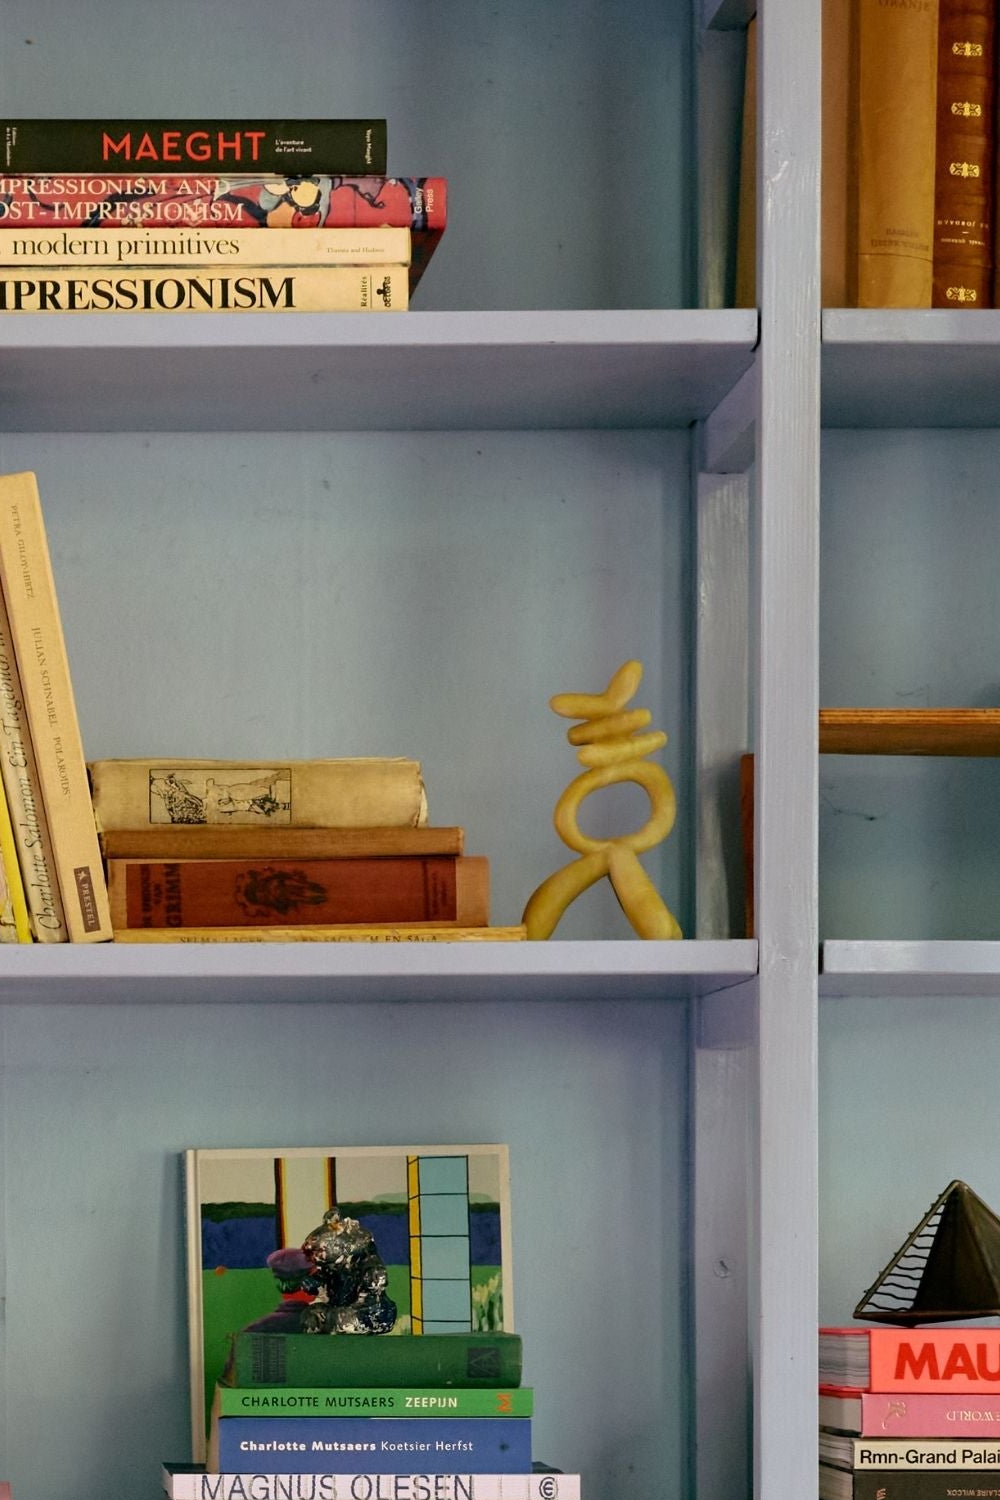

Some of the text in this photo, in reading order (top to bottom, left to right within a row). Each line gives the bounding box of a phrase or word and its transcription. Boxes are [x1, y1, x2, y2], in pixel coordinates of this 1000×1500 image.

[101, 131, 266, 162] MAEGHT
[176, 178, 232, 196] AND
[51, 201, 244, 222] IMPRESSIONISM
[12, 232, 241, 262] modern primitives
[31, 626, 72, 800] JULIAN SCHNABEL POLAROIDS
[19, 777, 62, 930] Charlotte Salomon
[241, 1396, 458, 1409] CHARLOTTE MUTSAERS ZEEPIJN
[946, 1410, 994, 1422] WORLD
[239, 1440, 474, 1452] Charlotte Mutsaers Koetsier Herfst
[859, 1449, 957, 1465] Rmn-Grand
